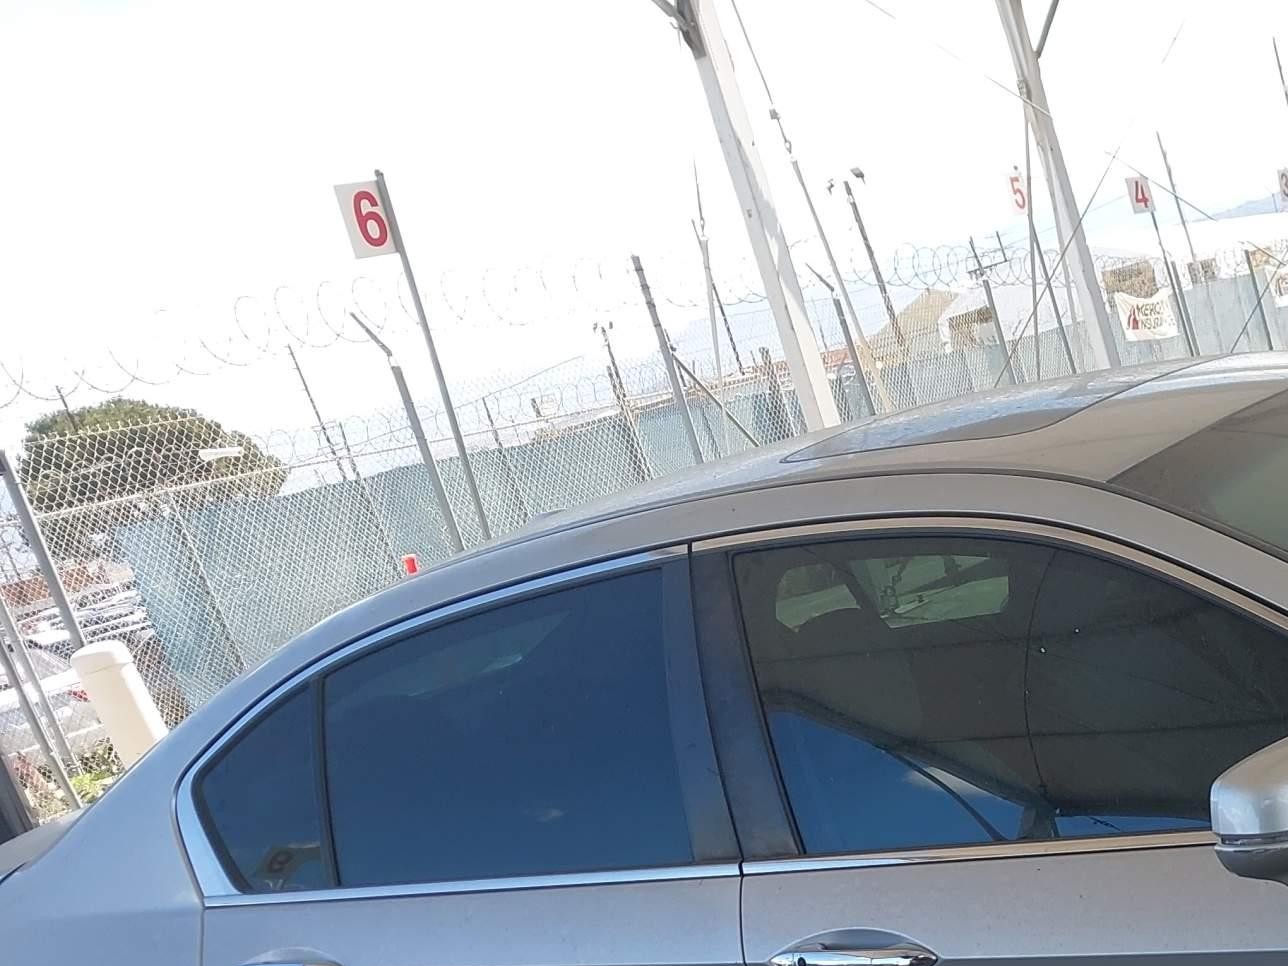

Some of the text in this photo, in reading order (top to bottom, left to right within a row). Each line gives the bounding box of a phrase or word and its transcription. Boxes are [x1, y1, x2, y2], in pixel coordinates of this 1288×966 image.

[1009, 176, 1026, 209] 5
[1134, 180, 1150, 209] 4
[353, 190, 388, 247] 6
